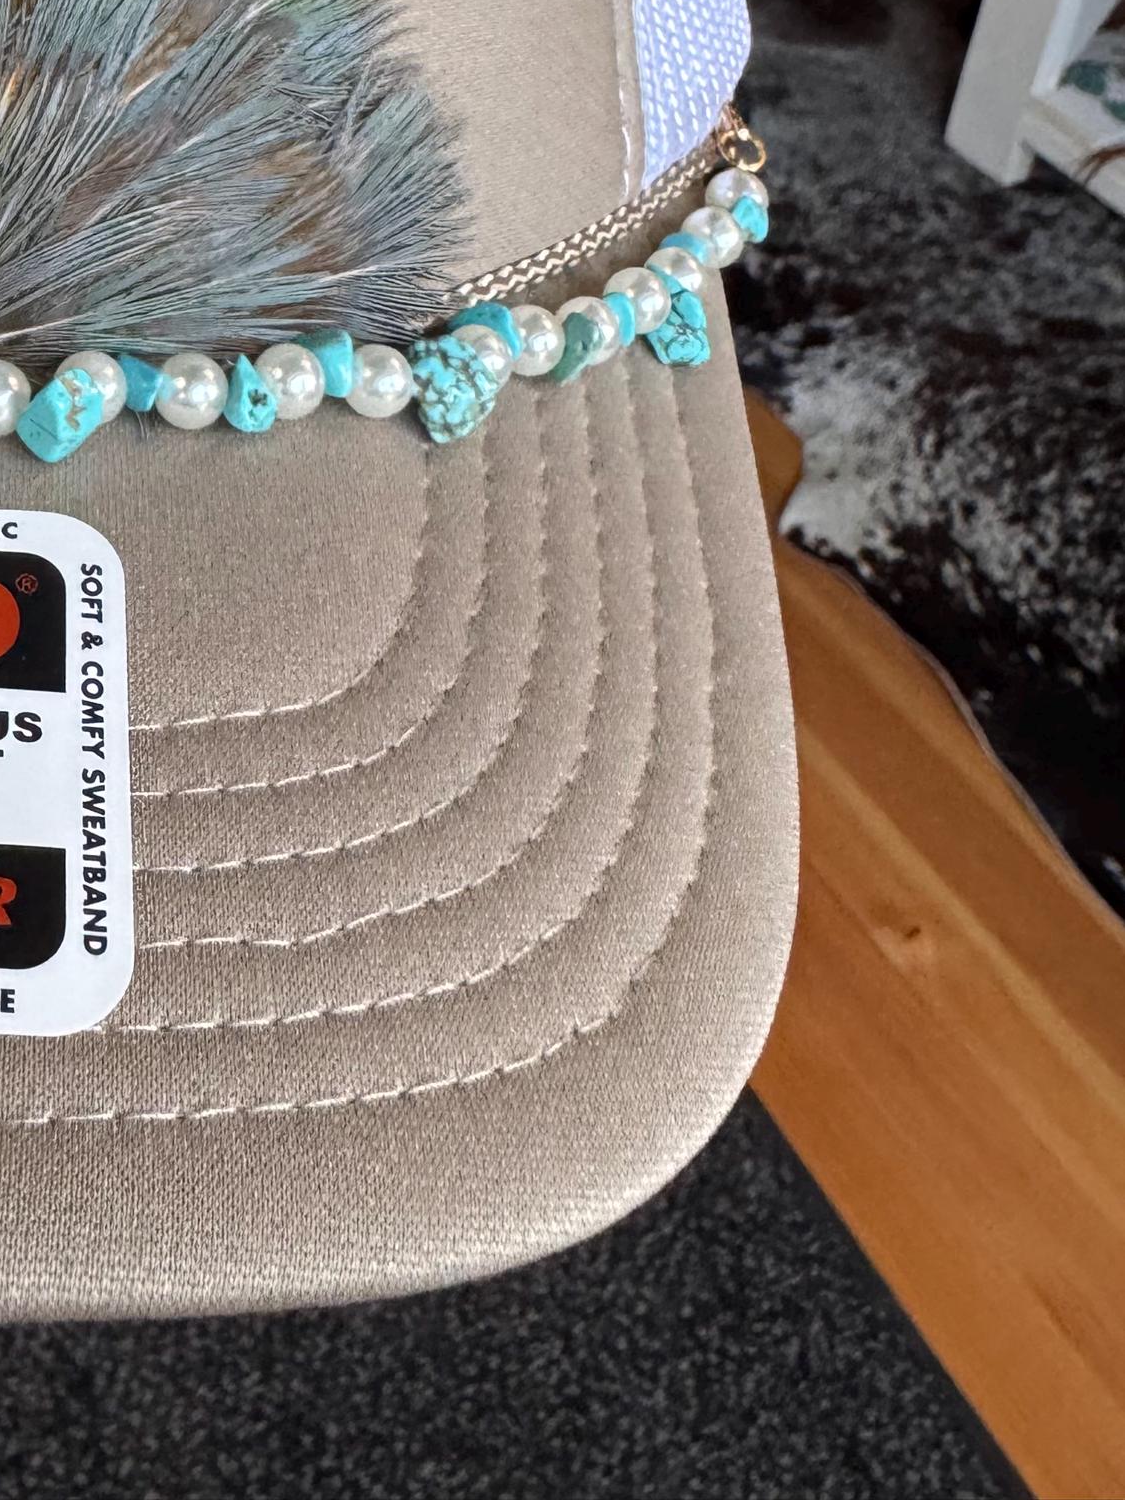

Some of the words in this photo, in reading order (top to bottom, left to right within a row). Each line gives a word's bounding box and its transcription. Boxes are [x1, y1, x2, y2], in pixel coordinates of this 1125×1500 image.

[80, 563, 103, 624] SOFT
[81, 631, 104, 650] &
[81, 661, 105, 760] COMFY
[81, 768, 108, 956] SWEATBAND
